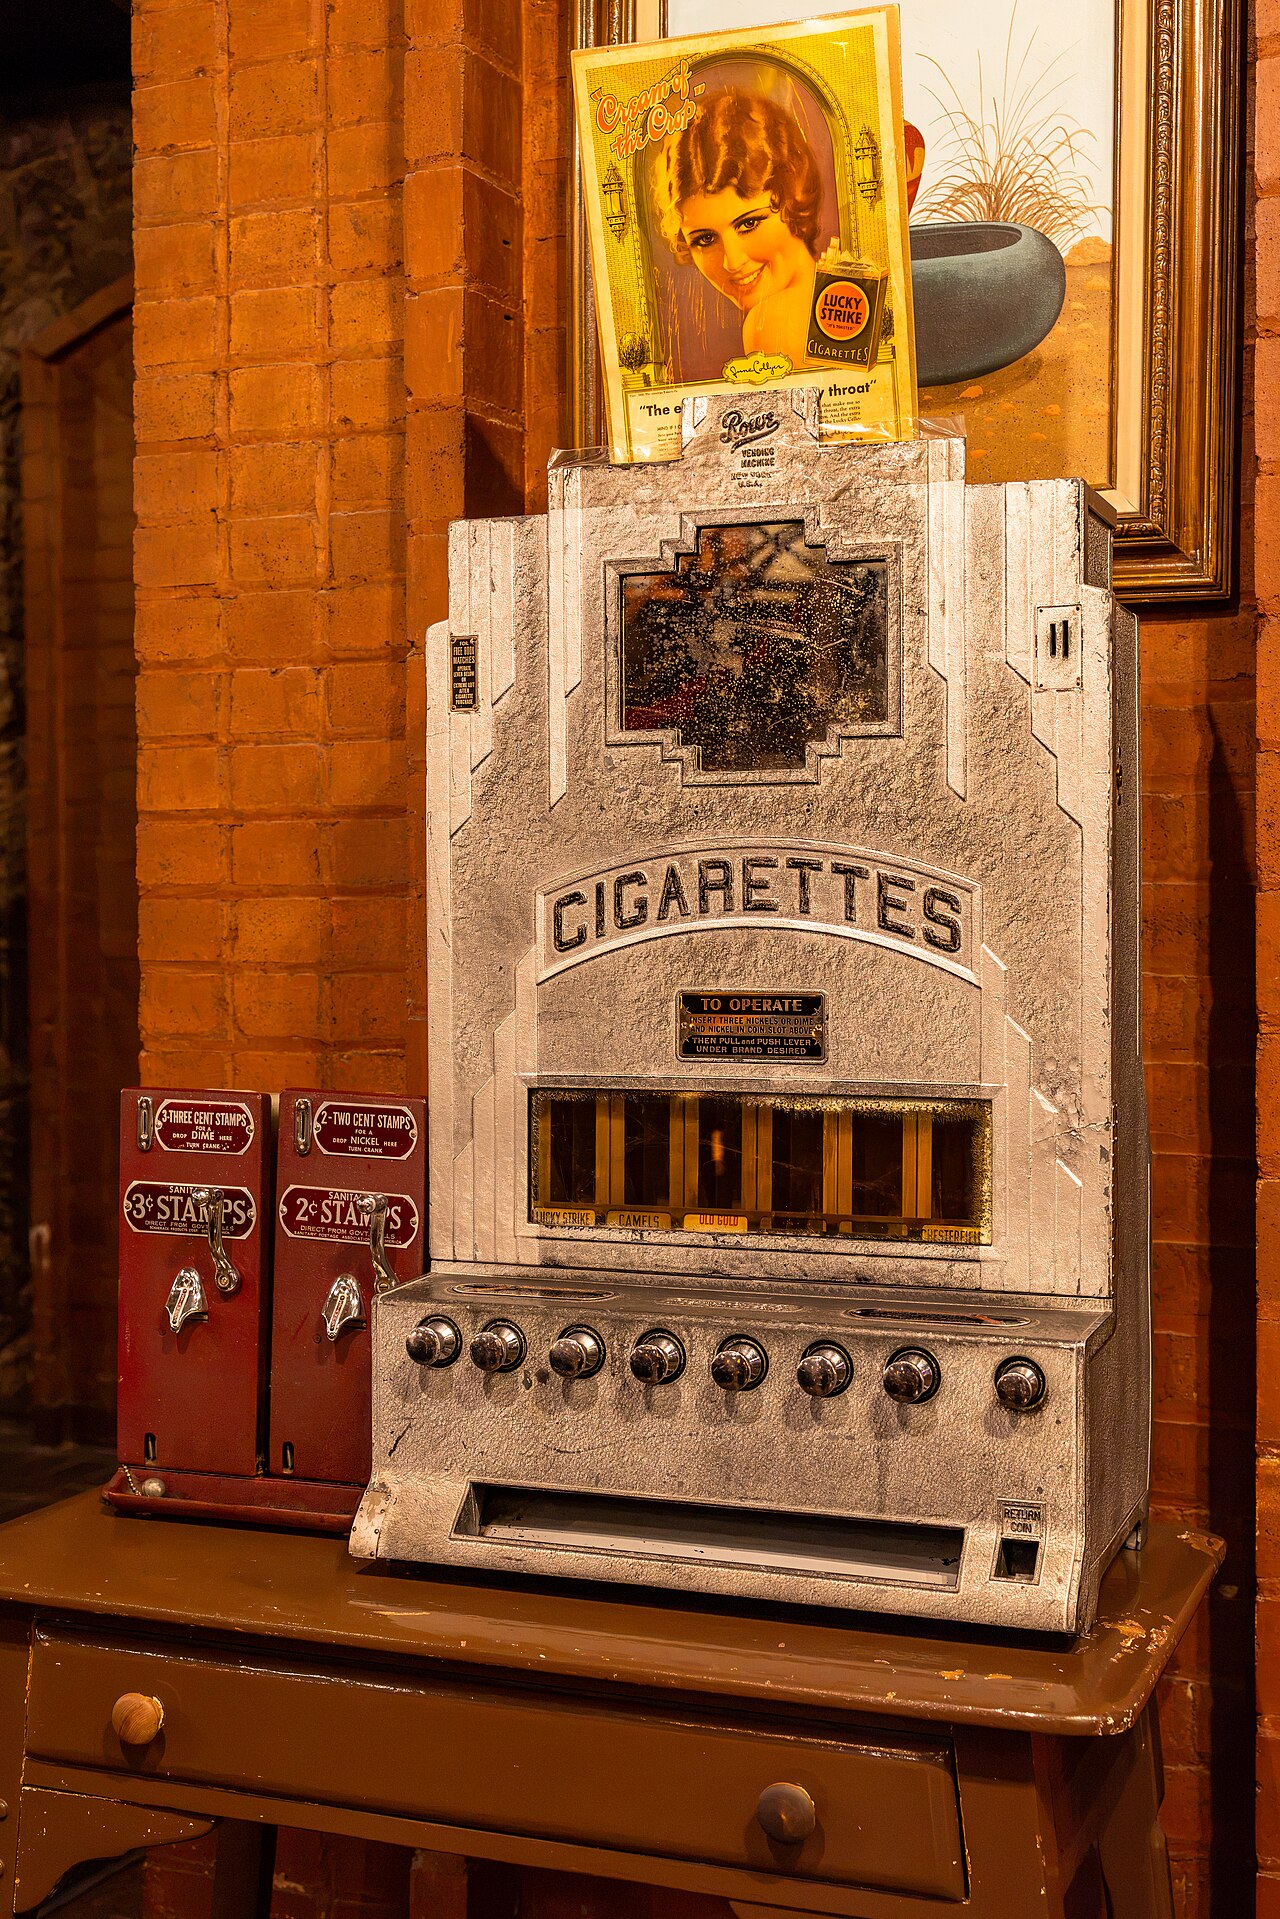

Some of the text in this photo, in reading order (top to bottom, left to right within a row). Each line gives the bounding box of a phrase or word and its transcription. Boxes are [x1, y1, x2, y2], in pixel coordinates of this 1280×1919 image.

[671, 59, 693, 100] of
[610, 119, 649, 160] the
[824, 293, 862, 310] LUCKY
[820, 307, 862, 325] STRIKE
[807, 339, 869, 361] CIGARETTES
[720, 410, 780, 450] Rowe
[742, 447, 775, 458] VENDING
[741, 458, 775, 468] MACHINE
[553, 856, 963, 953] CIGARETTES
[701, 998, 803, 1012] TO OPERATE
[690, 1016, 814, 1026] INSERT THREE NICKELS OR DIME
[690, 1025, 706, 1033] AND
[708, 1026, 734, 1034] NICKEL
[747, 1026, 765, 1034] COIN
[768, 1027, 786, 1035] SLOT
[789, 1027, 813, 1035] ABOVE
[692, 1037, 717, 1045] THEN
[757, 1038, 781, 1046] PUSH
[783, 1038, 811, 1047] LEVER
[696, 1046, 807, 1055] UNDER BRAND DESIRED
[161, 1109, 247, 1127] 3-THREE CENT STAMPS
[353, 1112, 376, 1128] CENT
[377, 1114, 411, 1130] STAMPS
[191, 1131, 215, 1141] DIME
[350, 1136, 380, 1146] NICKEL
[535, 1211, 591, 1226] LUCKY STRIKE
[619, 1214, 660, 1228] CAMELS
[699, 1214, 739, 1227] OLD GOLD
[300, 1225, 325, 1233] DIRECT
[1004, 1508, 1041, 1521] RETURN
[1010, 1521, 1032, 1533] COIN
